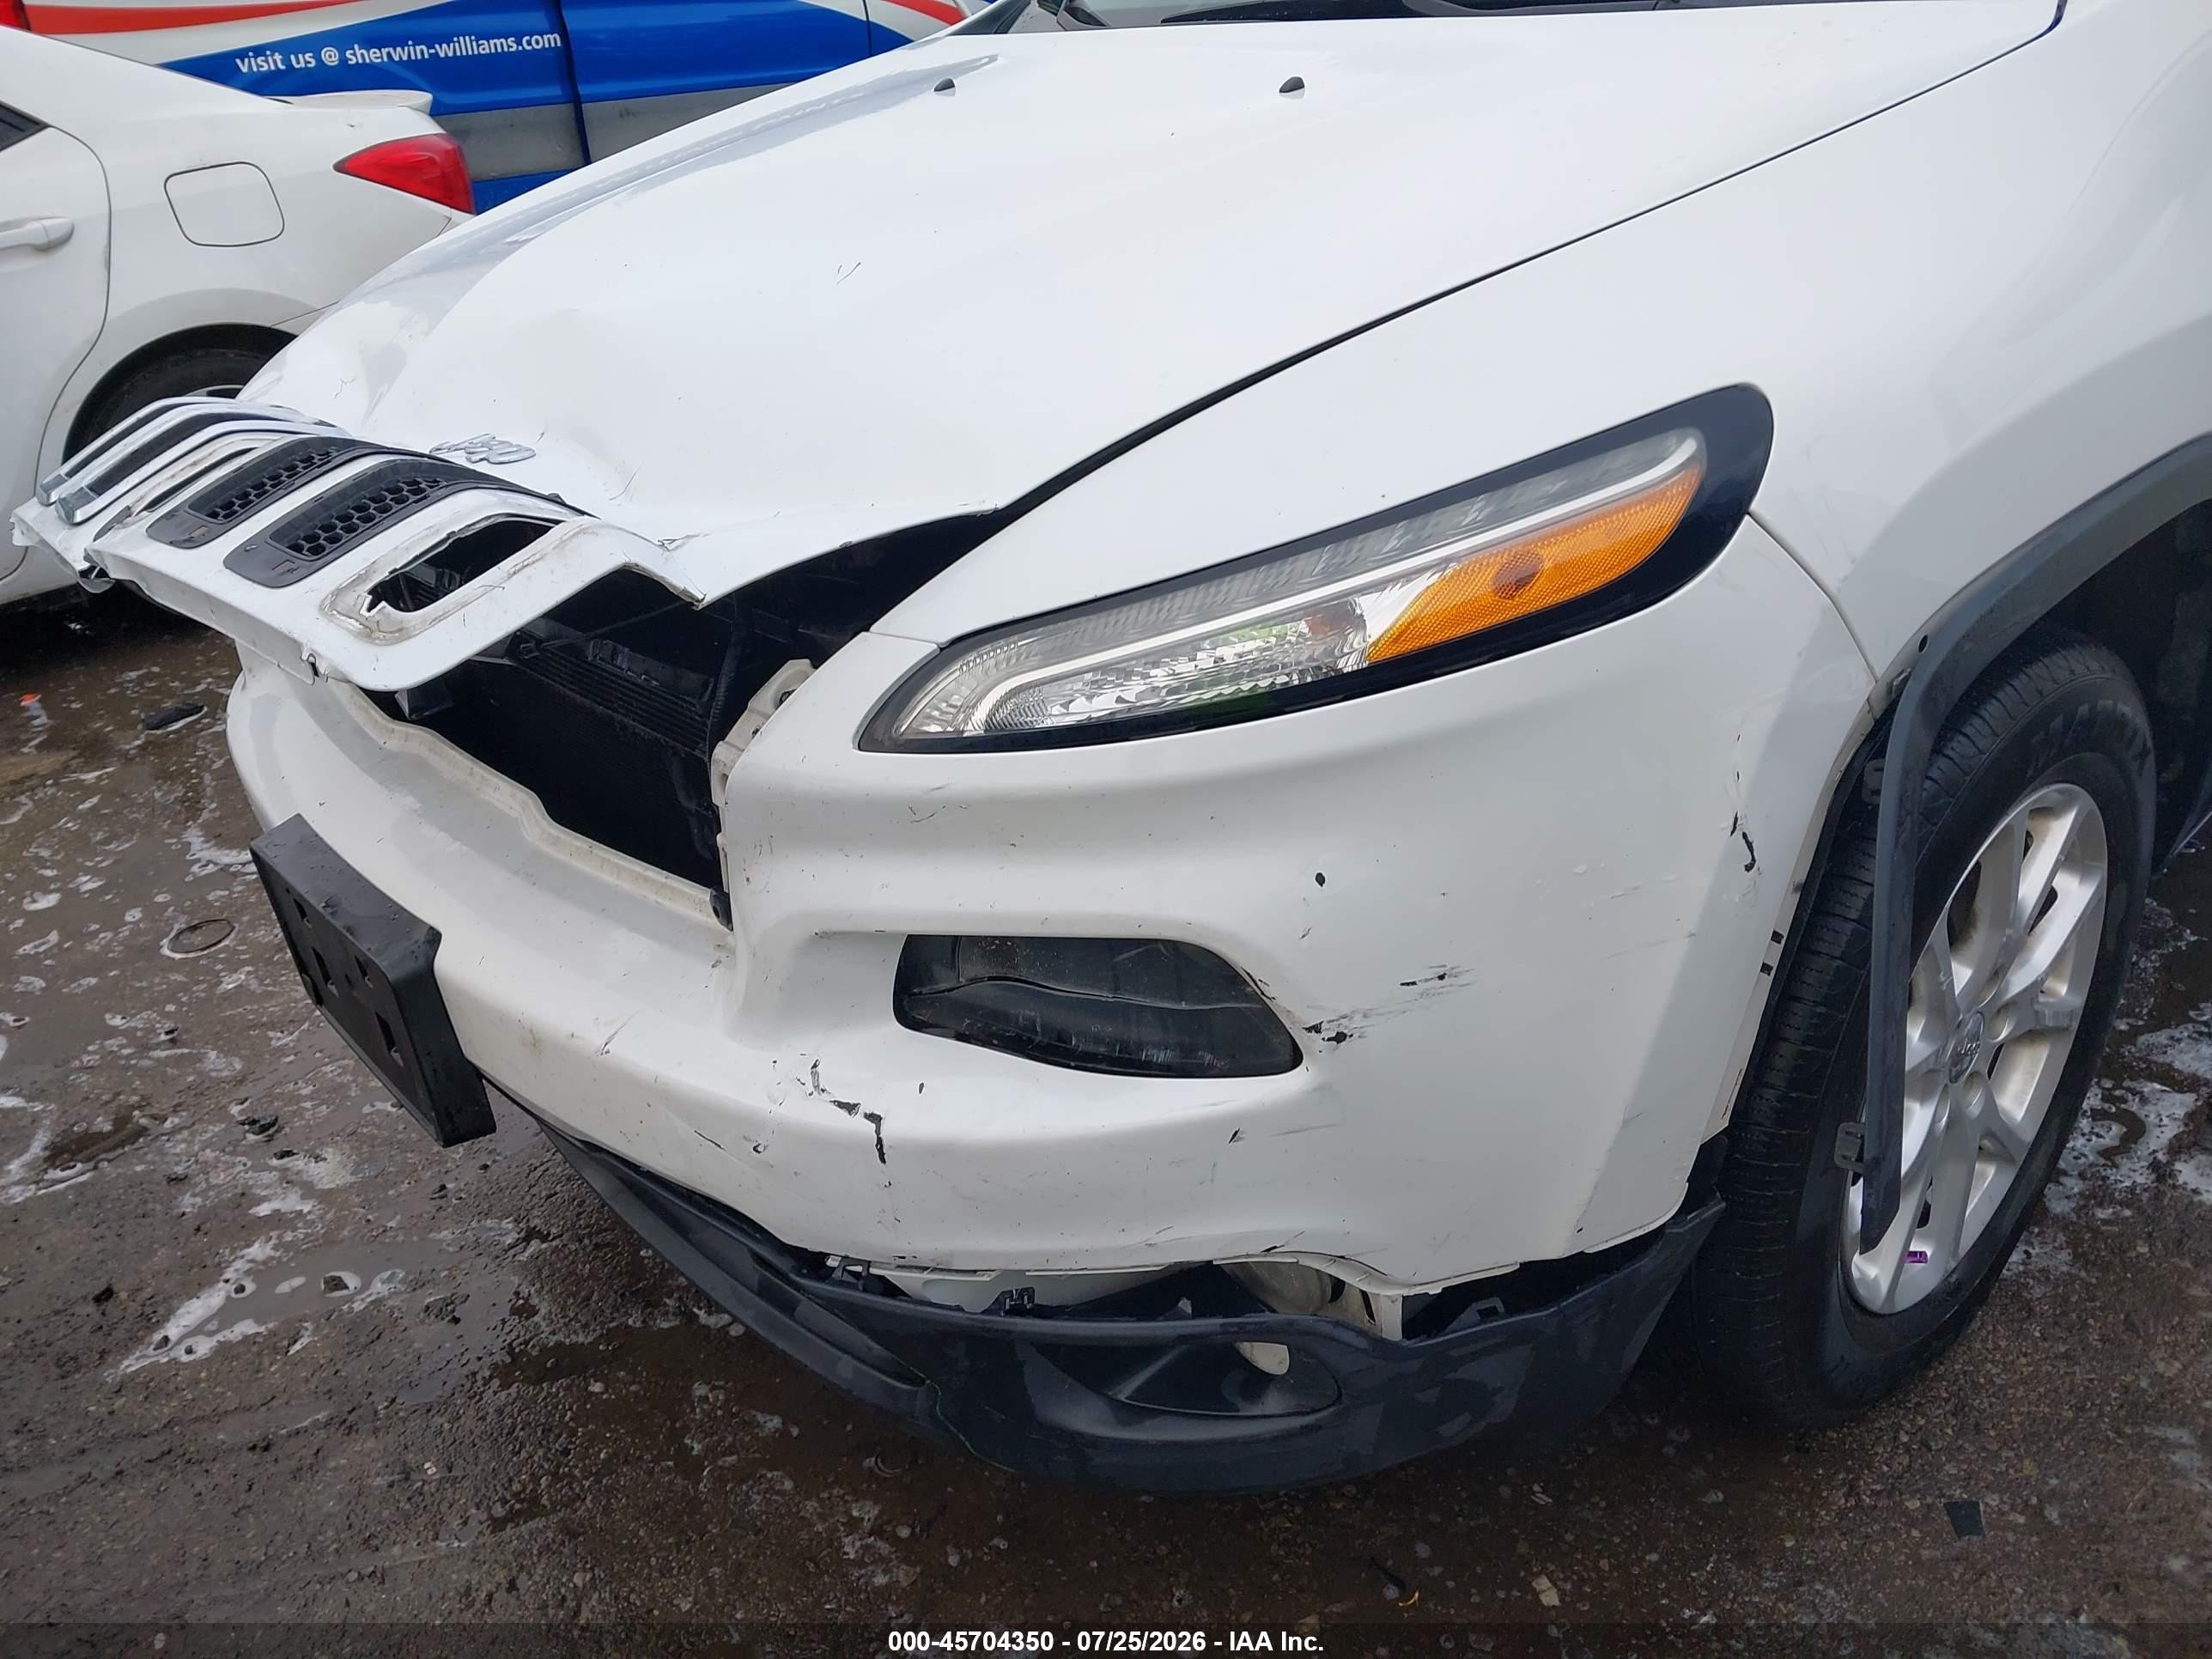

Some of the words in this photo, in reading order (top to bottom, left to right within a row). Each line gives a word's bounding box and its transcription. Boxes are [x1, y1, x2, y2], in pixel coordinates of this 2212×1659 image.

[234, 50, 286, 73] visit
[289, 52, 316, 69] us
[320, 46, 340, 66] @
[346, 31, 562, 65] sherwin-williams.com
